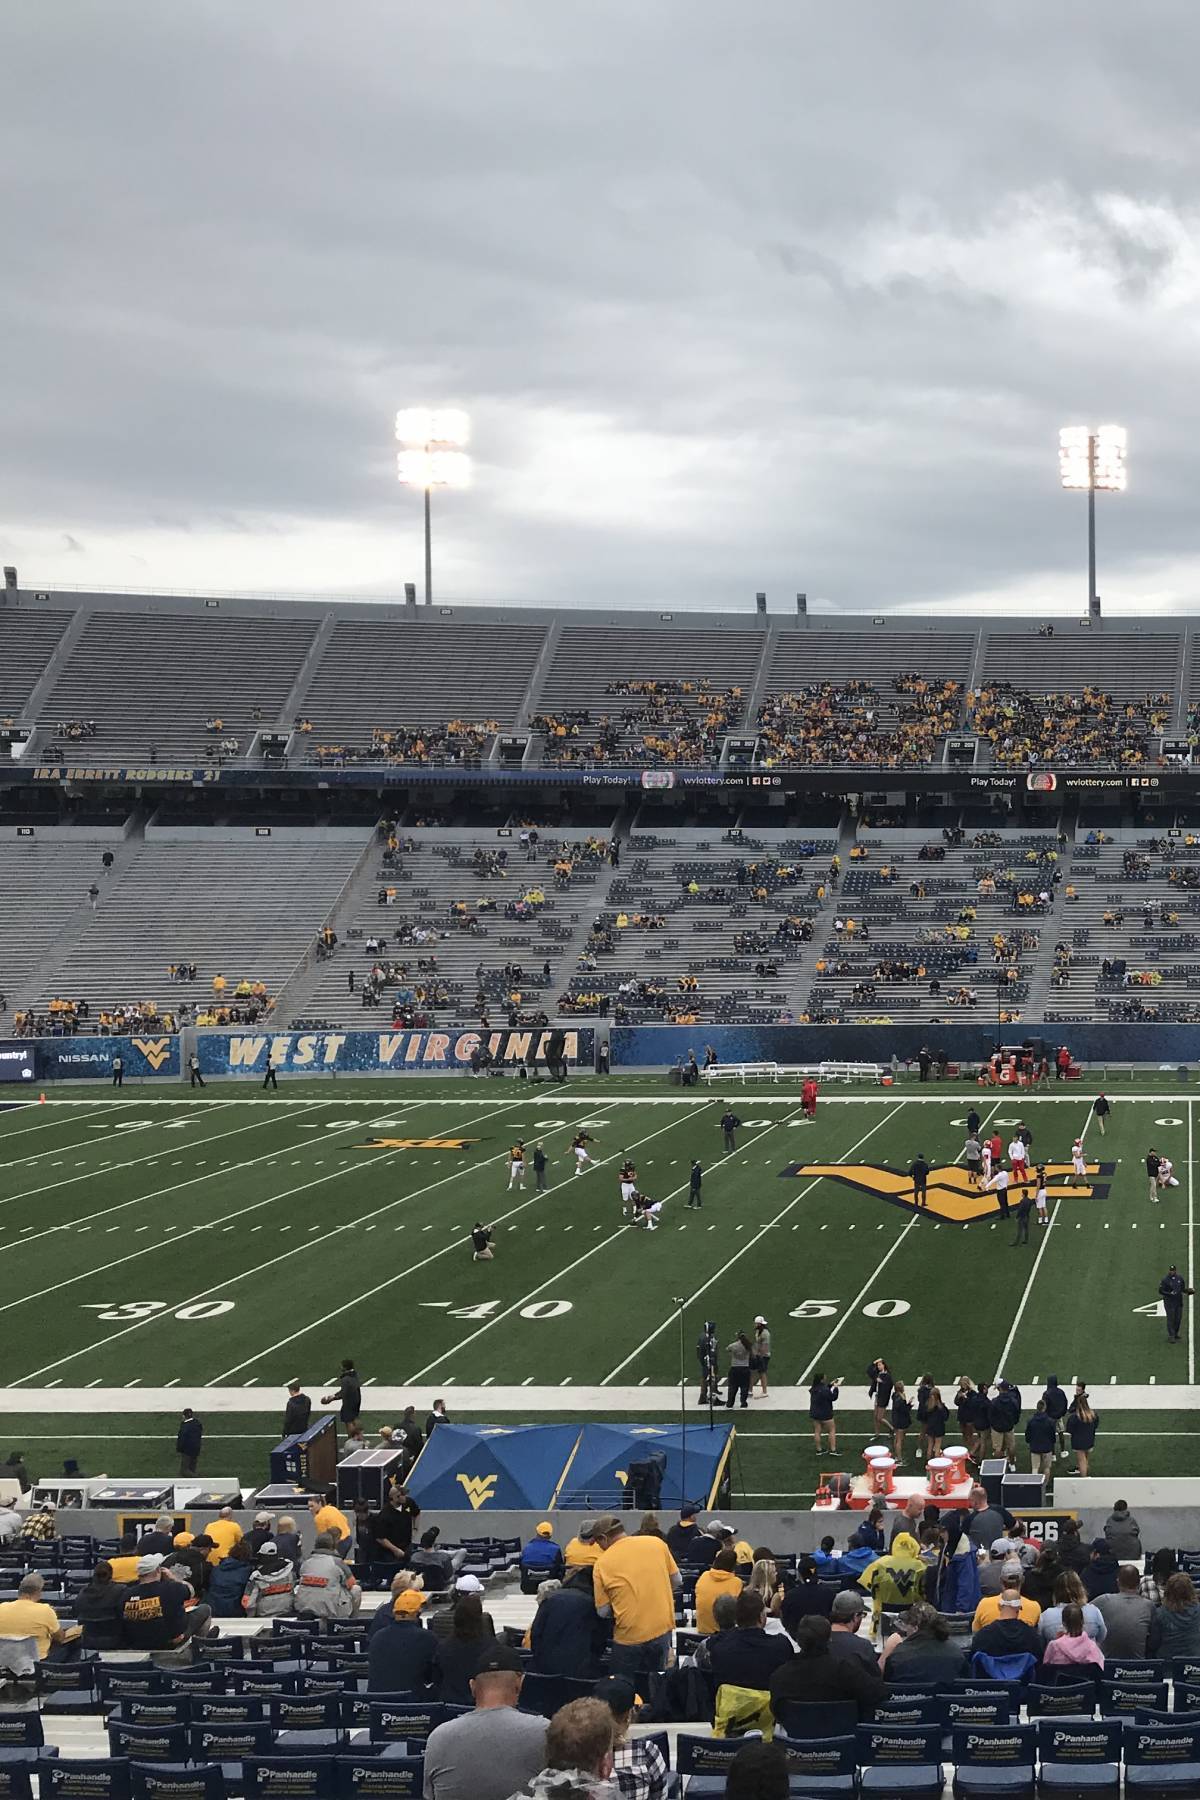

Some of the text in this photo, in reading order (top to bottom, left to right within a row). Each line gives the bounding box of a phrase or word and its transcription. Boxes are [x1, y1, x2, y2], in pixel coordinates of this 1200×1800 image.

[33, 769, 60, 779] IRA
[203, 770, 221, 781] 21
[583, 776, 743, 787] Play Today! wvlottery.com
[971, 778, 1123, 788] Play Today! wvlottery.com
[229, 1035, 345, 1066] WEST
[0, 1051, 27, 1061] untry!
[58, 1054, 109, 1063] NISSAN
[97, 1301, 236, 1319] 30
[447, 1301, 574, 1319] 40
[788, 1299, 911, 1318] 50
[875, 1472, 886, 1483] G
[934, 1472, 945, 1483] G
[1023, 1521, 1059, 1541] 126
[140, 1705, 177, 1713] Panhandle
[212, 1706, 249, 1714] Panhandle
[289, 1705, 325, 1713] Panhandle
[392, 1714, 431, 1722] Panhandle
[884, 1710, 922, 1718] Panhandle
[0, 1721, 26, 1729] nhandle
[129, 1737, 170, 1746] Panhandle
[213, 1735, 256, 1744] Panhandle
[882, 1737, 927, 1746] Panhandle
[979, 1737, 1022, 1746] Panhandle
[1066, 1734, 1109, 1743] Panhandle
[1150, 1736, 1194, 1746] Panhandle
[797, 1750, 841, 1758] Panhandle
[65, 1772, 112, 1781] Panhandle
[270, 1770, 318, 1779] Panhandle
[366, 1770, 414, 1779] Panhandle
[157, 1780, 206, 1789] Panhandle
